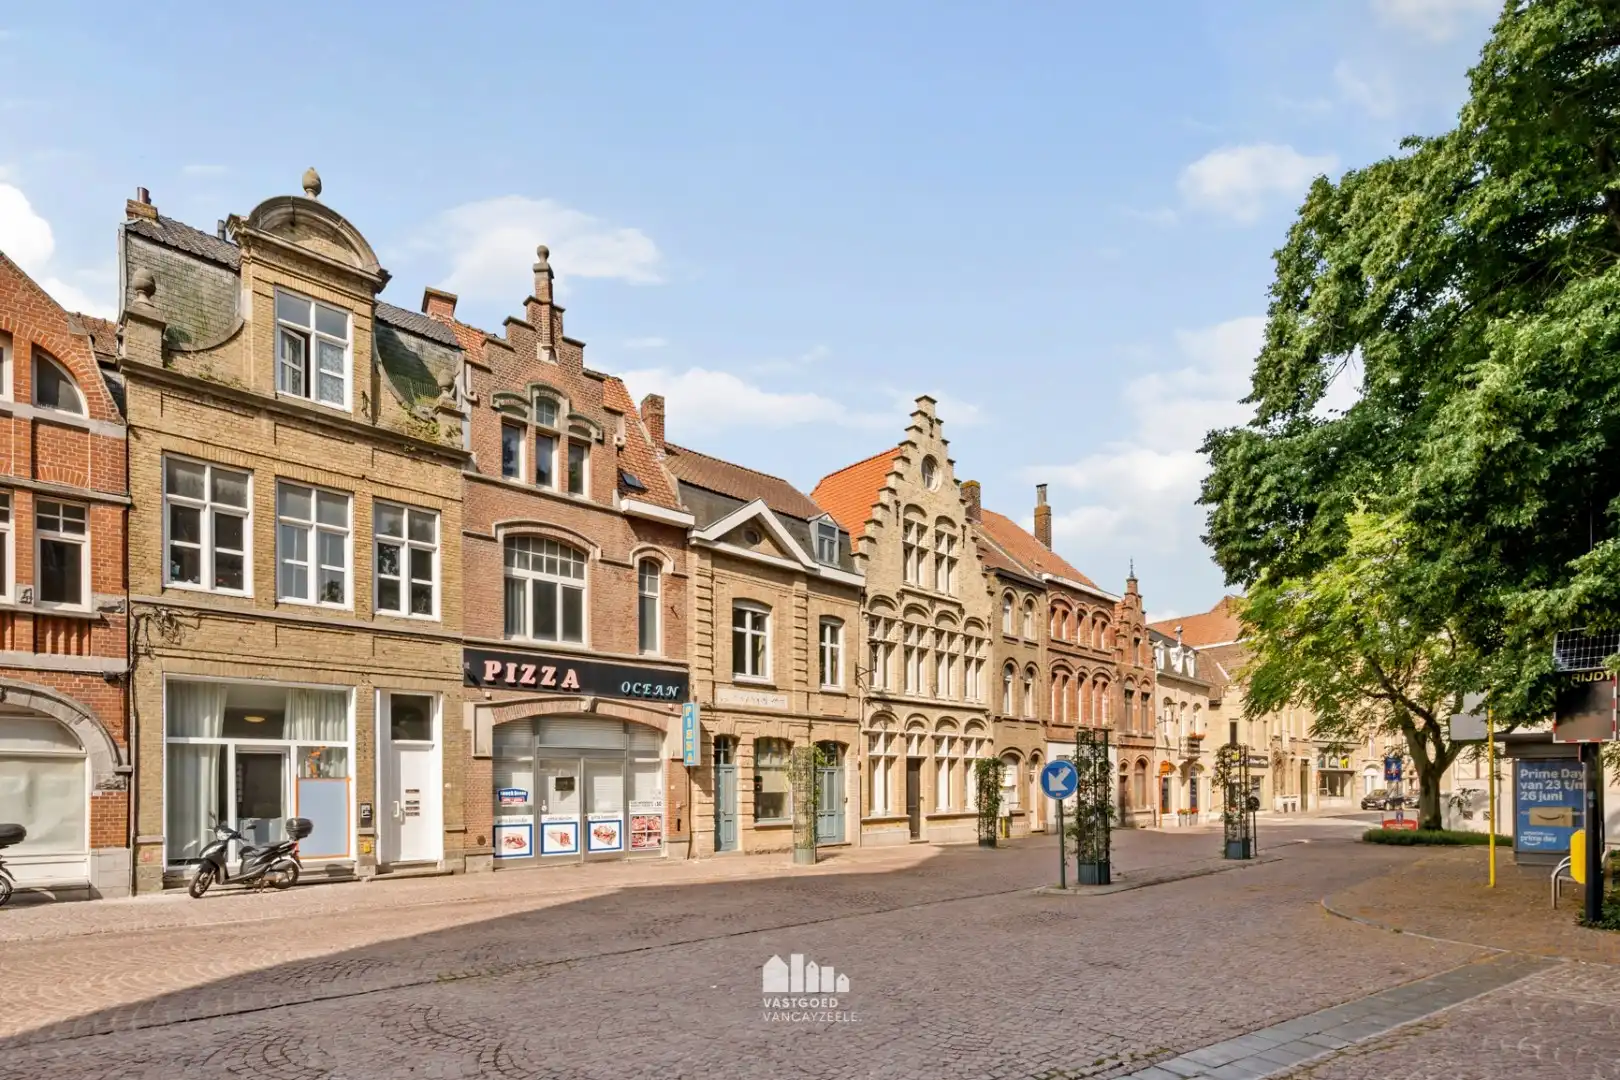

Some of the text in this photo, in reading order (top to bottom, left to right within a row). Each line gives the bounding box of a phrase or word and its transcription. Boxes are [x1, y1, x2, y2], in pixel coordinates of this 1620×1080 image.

[484, 660, 679, 697] PIZZA OCEAN
[1520, 768, 1585, 780] Prime Day
[1520, 781, 1543, 790] van
[1545, 780, 1561, 790] 23
[1520, 791, 1563, 802] 26 juni
